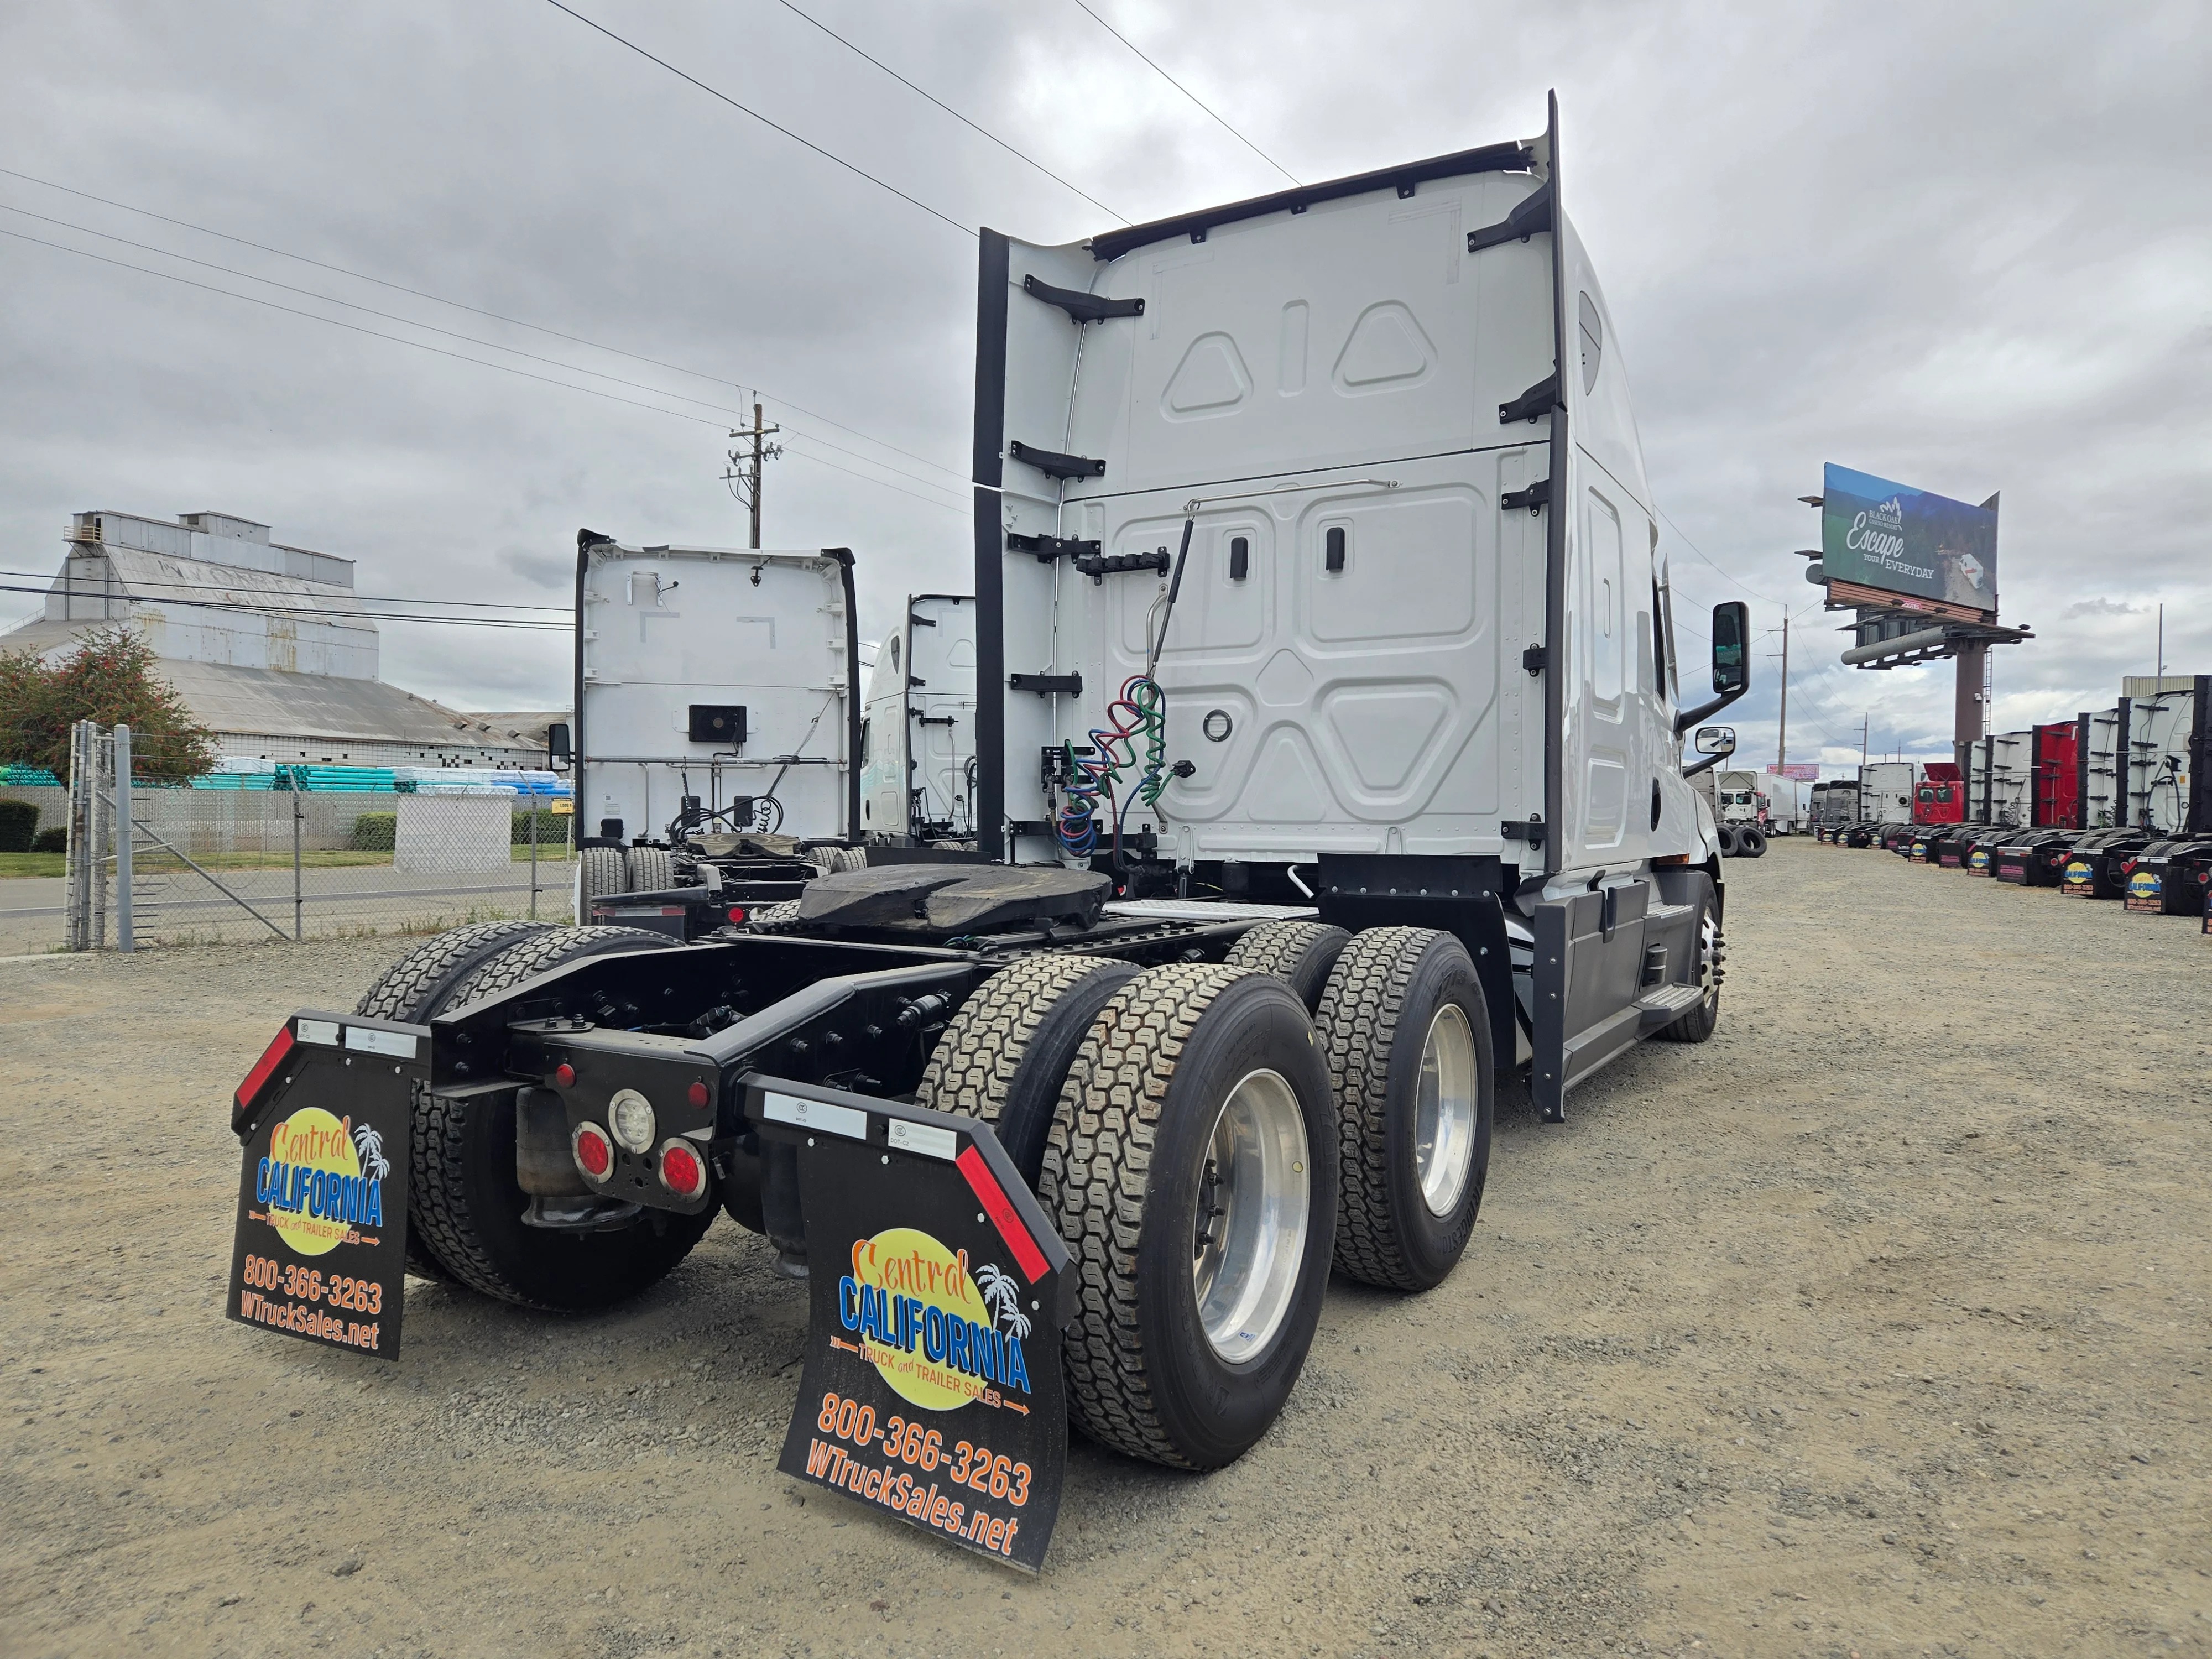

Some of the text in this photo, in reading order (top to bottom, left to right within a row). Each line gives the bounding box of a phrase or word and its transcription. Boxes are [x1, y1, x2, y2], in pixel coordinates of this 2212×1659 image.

[1846, 511, 1904, 565] Escape
[1869, 510, 1899, 523] BLACK OAK
[1869, 518, 1884, 526] CASINO
[1864, 554, 1934, 578] YOUR EVERYDAY
[270, 1115, 351, 1165] Central
[890, 1138, 909, 1146] DOT-C2
[256, 1156, 383, 1227] CALIFORNIA
[266, 1213, 359, 1245] TRUCK and TRAILER SALES
[244, 1254, 383, 1314] 800-366-3263
[852, 1239, 971, 1304] Central
[241, 1290, 379, 1349] WTruckSales.net
[839, 1275, 1031, 1394] CALIFORNIA
[859, 1343, 1001, 1408] TRUCK and TRAILER SALES
[817, 1392, 1032, 1506] 800-366-3263
[806, 1438, 1018, 1556] WTruckSales.net
